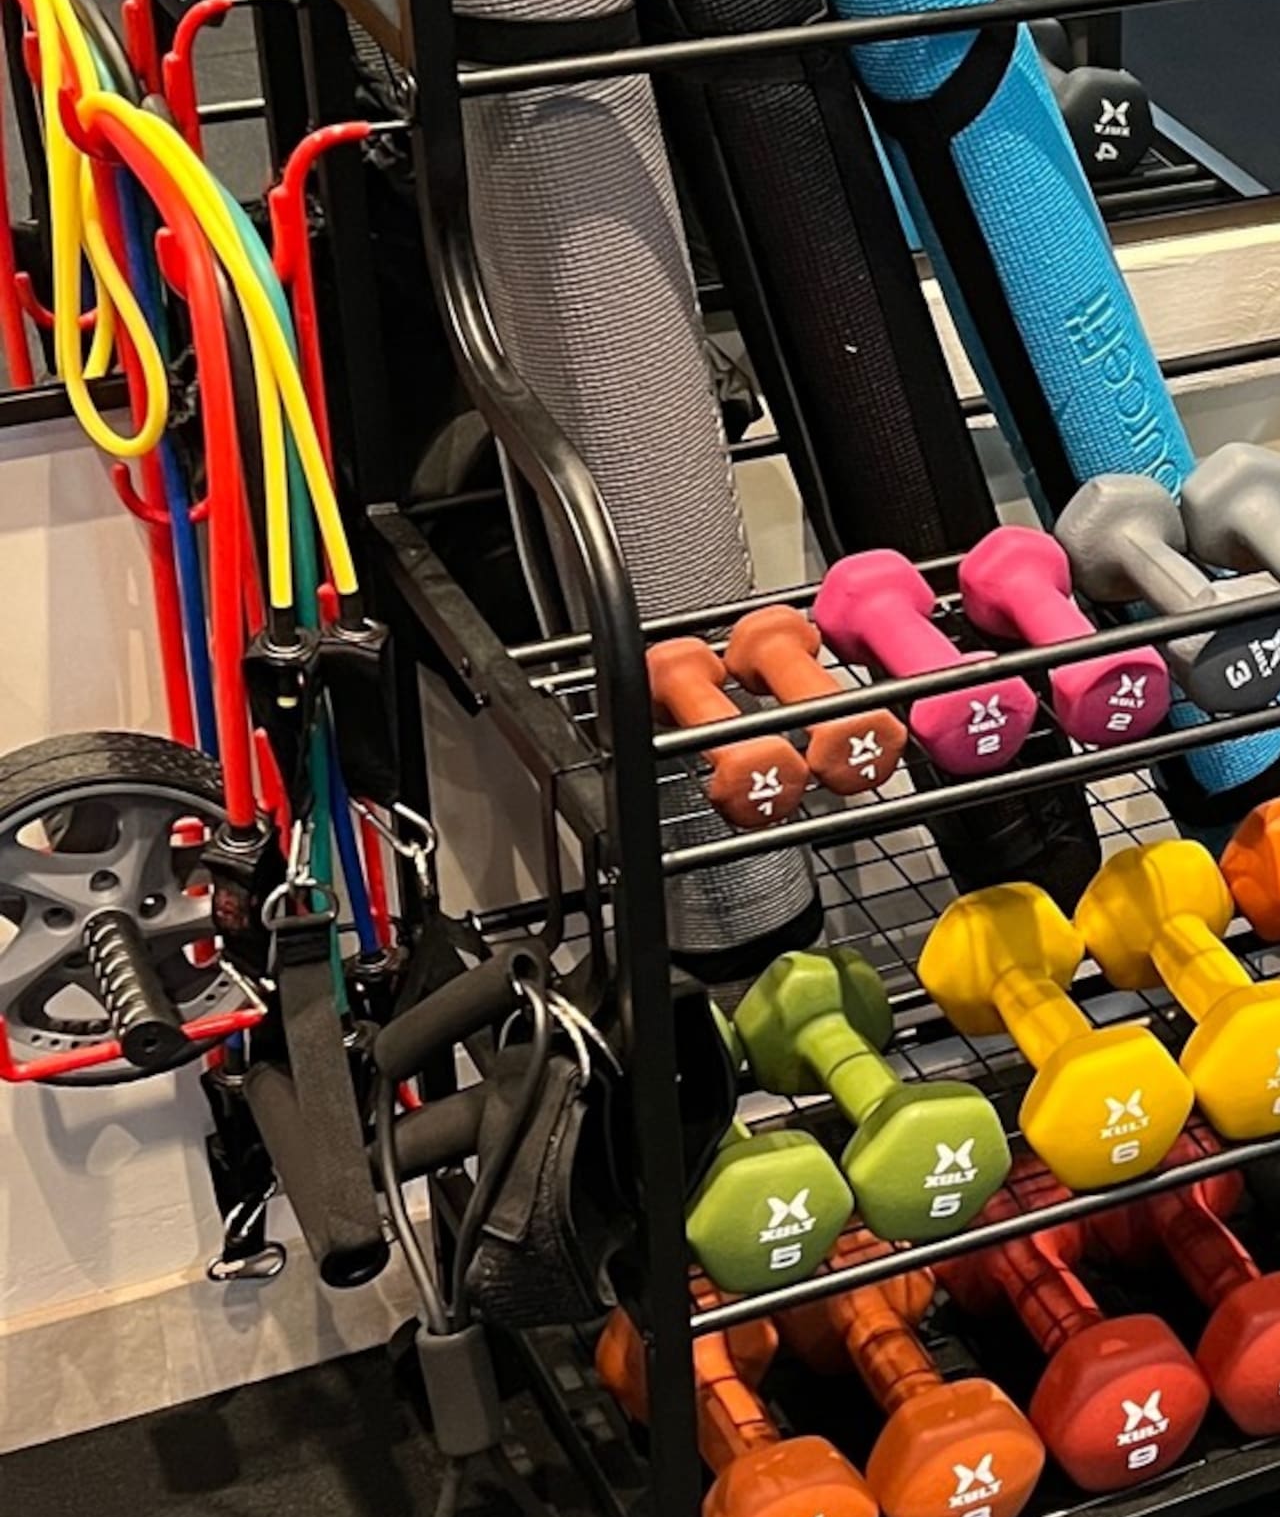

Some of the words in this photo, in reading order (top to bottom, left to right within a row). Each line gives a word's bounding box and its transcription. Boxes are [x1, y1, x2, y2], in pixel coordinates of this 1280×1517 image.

[1224, 658, 1251, 689] 3
[1106, 712, 1132, 731] 2
[976, 735, 1001, 756] 2
[1100, 1116, 1150, 1140] XULT
[1111, 1140, 1140, 1165] 6
[924, 1168, 979, 1189] XULT
[930, 1193, 962, 1218] 5
[759, 1217, 817, 1243] XULT
[770, 1244, 801, 1270] 5
[1116, 1417, 1170, 1447] XULT
[1127, 1443, 1159, 1470] 9
[949, 1479, 1003, 1509] XULT
